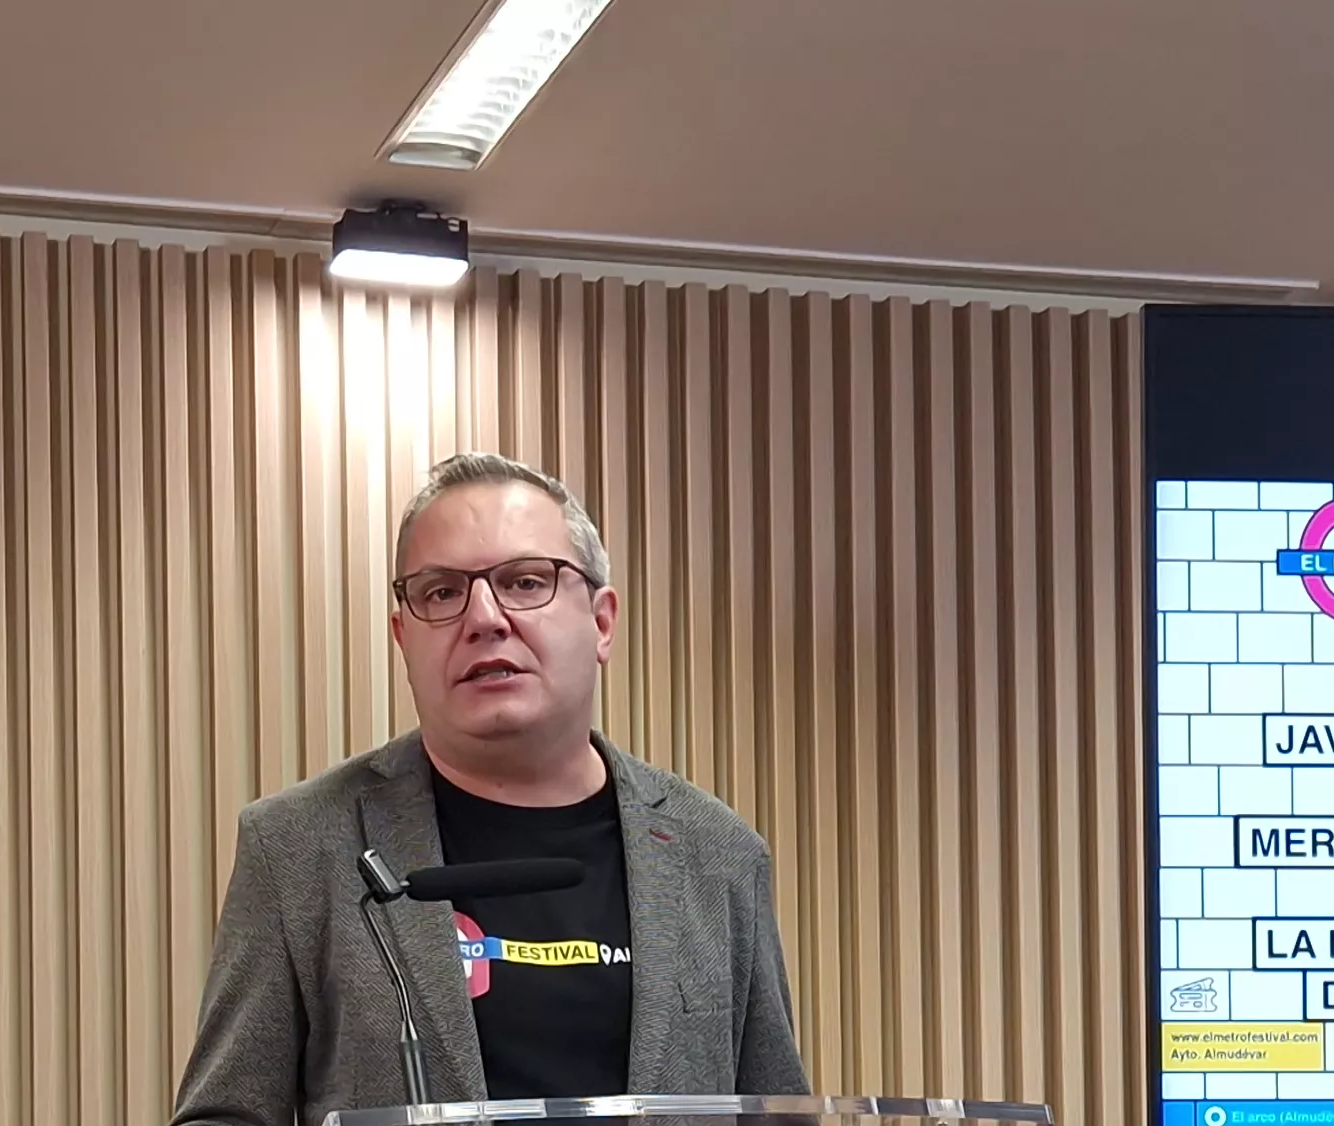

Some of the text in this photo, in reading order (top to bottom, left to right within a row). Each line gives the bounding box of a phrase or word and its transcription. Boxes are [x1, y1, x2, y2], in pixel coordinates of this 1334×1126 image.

[1301, 554, 1327, 573] EL
[506, 944, 595, 961] FESTIVAL
[1267, 929, 1317, 959] LA
